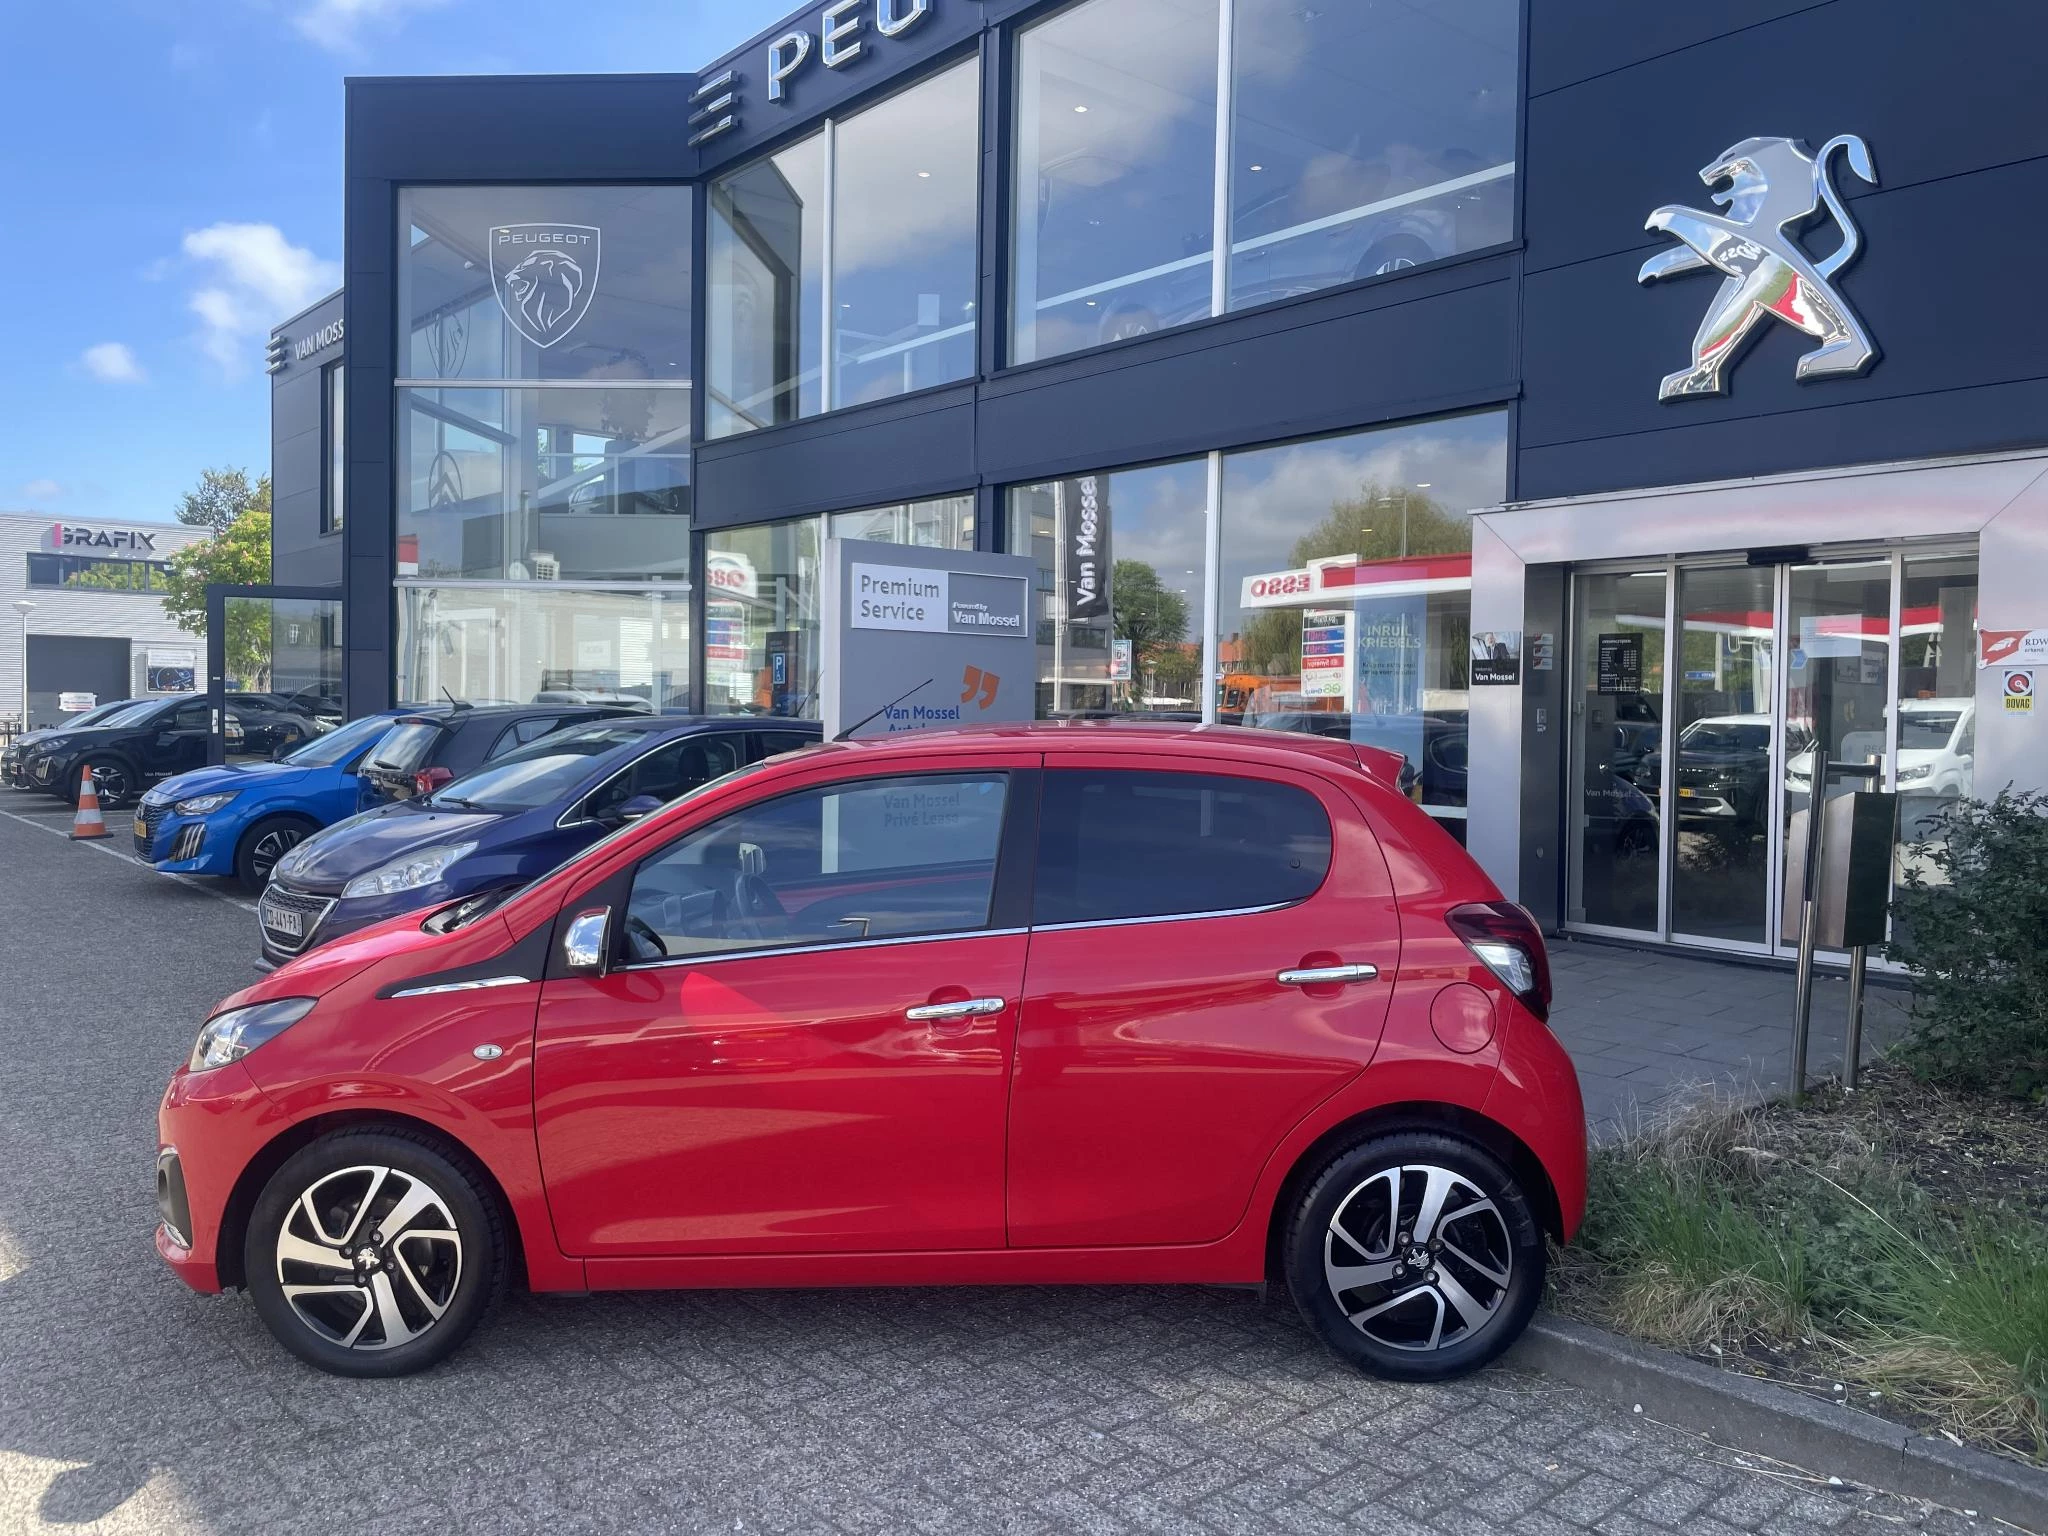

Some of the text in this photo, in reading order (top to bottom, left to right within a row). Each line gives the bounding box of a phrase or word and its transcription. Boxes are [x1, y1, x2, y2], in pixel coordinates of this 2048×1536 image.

[498, 233, 591, 246] PEUGEOT
[294, 318, 345, 360] VAN MOSS
[861, 575, 940, 598] Premium
[1076, 562, 1097, 606] Van
[861, 600, 925, 620] Service
[953, 611, 1020, 627] Van Mossel
[1367, 625, 1412, 636] INRUIL
[1358, 637, 1421, 648] KRIEBELS
[2025, 638, 2048, 646] RDW
[776, 657, 783, 669] P
[1475, 672, 1515, 681] Van Mossel
[2006, 698, 2030, 709] BOVAG
[883, 705, 960, 720] Van Mossel
[883, 791, 960, 808] Van Mossel
[1586, 789, 1601, 797] Van
[884, 811, 920, 827] Privé
